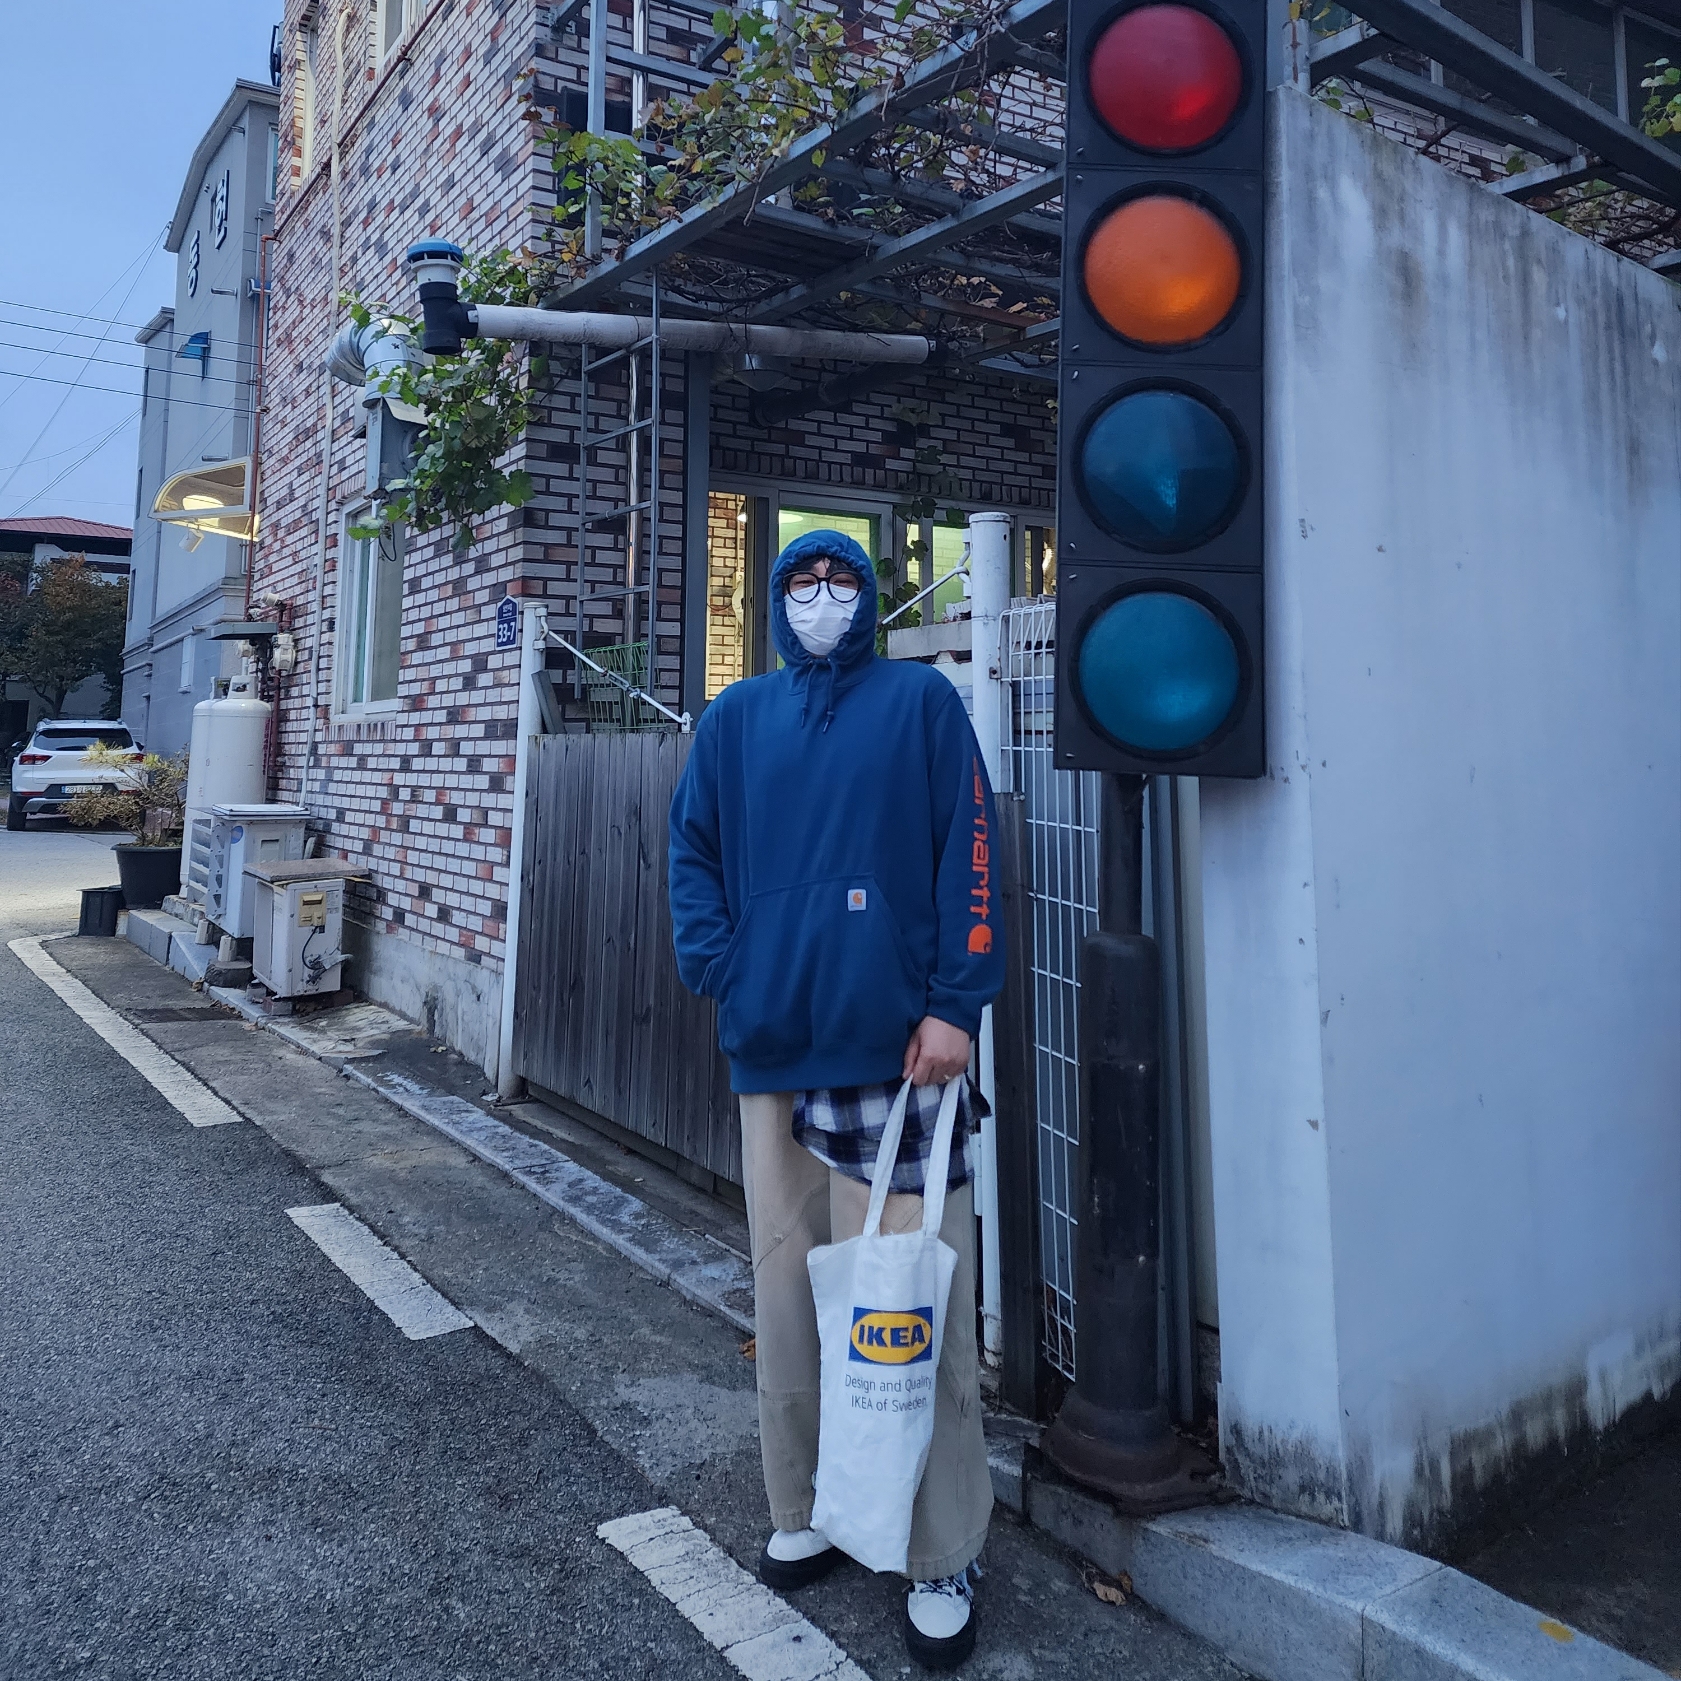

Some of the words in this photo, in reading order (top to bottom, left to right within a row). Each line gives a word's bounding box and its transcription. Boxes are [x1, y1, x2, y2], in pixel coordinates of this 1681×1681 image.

[498, 621, 516, 643] 33-7
[858, 1323, 927, 1348] IKEA
[845, 1373, 876, 1394] Design
[880, 1377, 902, 1392] and
[904, 1375, 933, 1393] Quality
[851, 1394, 873, 1410] IKEA
[876, 1398, 888, 1412] of
[891, 1396, 927, 1413] Sweden
